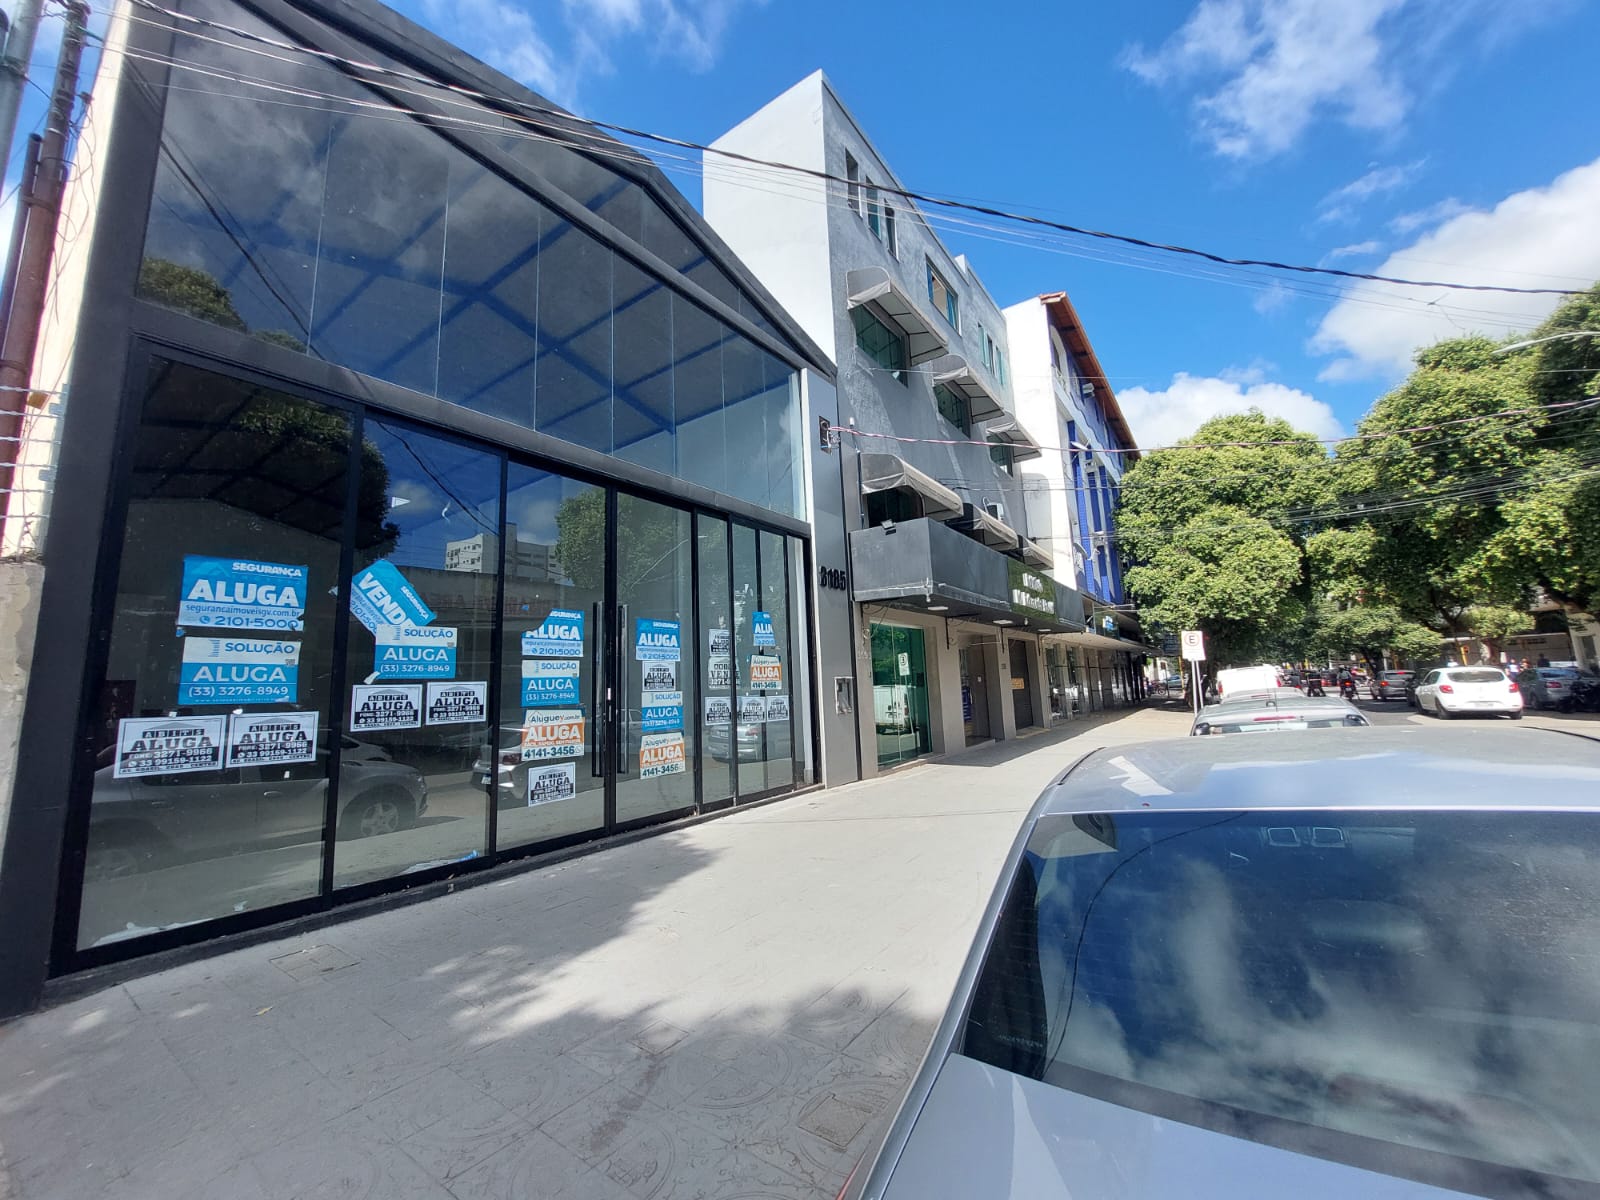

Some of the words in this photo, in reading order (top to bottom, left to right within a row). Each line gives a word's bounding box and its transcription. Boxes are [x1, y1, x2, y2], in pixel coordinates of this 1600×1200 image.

[232, 562, 302, 577] SEGURANÇA
[187, 579, 299, 607] ALUGA
[215, 616, 298, 628] 2101-5000
[404, 628, 453, 638] SOLUÇÃO
[525, 624, 580, 640] ALUGA
[638, 632, 678, 647] ALUGA
[1189, 635, 1195, 644] E
[225, 642, 295, 654] SOLUÇÃO
[383, 648, 449, 661] ALUGA
[380, 664, 398, 673] (33)
[401, 664, 450, 672] 3276-8949
[541, 661, 577, 670] SOLUÇÃO
[193, 666, 287, 682] ALUGA
[753, 667, 780, 678] ALUGA
[527, 679, 574, 691] ALUGA
[188, 686, 216, 697] (33)
[218, 686, 289, 696] 3276-8949
[361, 701, 414, 711] ALUGA
[434, 697, 480, 706] ALUGA
[646, 707, 679, 718] ALUGA
[240, 731, 307, 743] ALUGA
[525, 725, 581, 742] ALUGA
[130, 737, 213, 751] ALUGA
[524, 745, 575, 759] 4141-3456
[642, 745, 682, 764] ALUGA
[642, 763, 679, 777] 4141-3456
[535, 777, 570, 790] ALUGA
